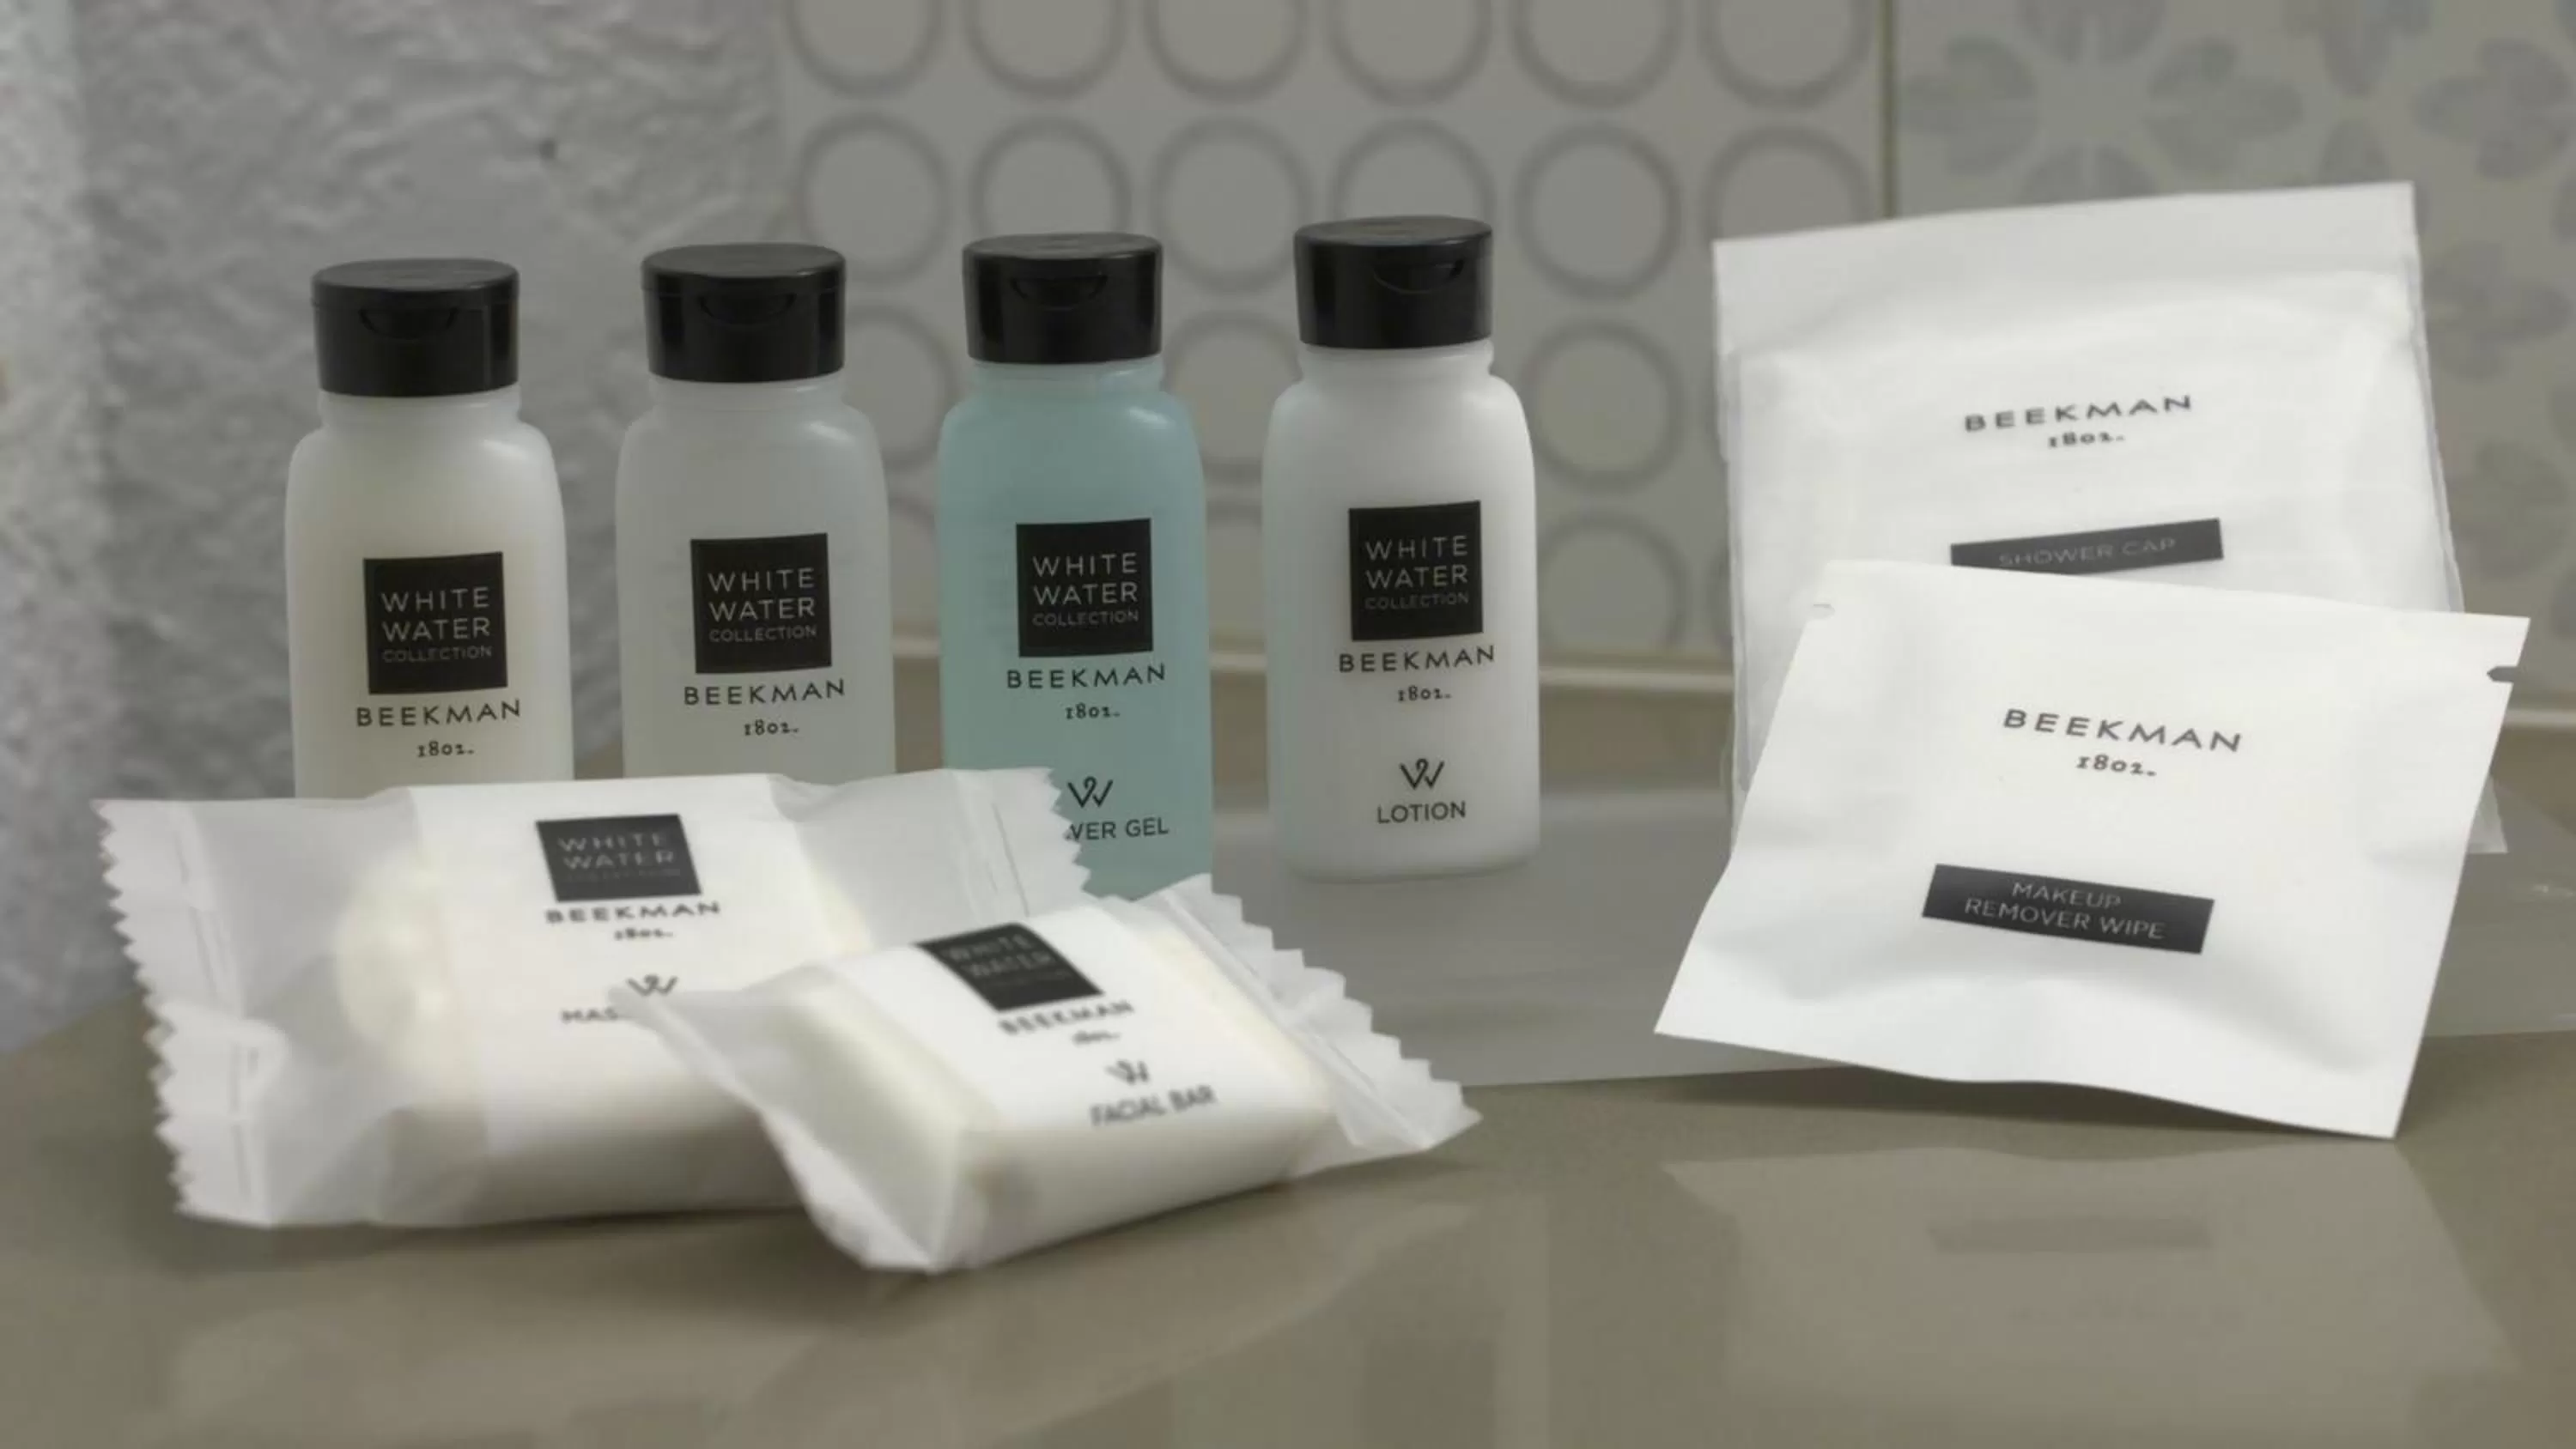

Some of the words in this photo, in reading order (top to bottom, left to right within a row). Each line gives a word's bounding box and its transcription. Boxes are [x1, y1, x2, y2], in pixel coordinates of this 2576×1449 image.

[1965, 394, 2192, 433] BEEKMAN
[1364, 534, 1468, 561] WHITE
[1998, 543, 2114, 568] SHOWER
[2121, 537, 2178, 557] CAP
[1031, 551, 1138, 578] WHITE
[1364, 564, 1469, 591] WATER
[707, 567, 815, 592] WHITE
[381, 585, 489, 614] WHITE
[1032, 581, 1139, 606] WATER
[1364, 591, 1470, 610] COLLECTION
[708, 596, 816, 622] WATER
[1031, 609, 1139, 627] COLLECTION
[382, 616, 490, 643] WATER
[708, 623, 817, 644] COLLECTION
[382, 644, 493, 664] COLLECTION
[1338, 645, 1496, 673] BEEKMAN
[1006, 663, 1166, 690] BEEKMAN
[683, 678, 845, 706] BEEKMAN
[356, 699, 520, 727] BEEKMAN
[2003, 708, 2242, 753] BEEKMAN
[1376, 800, 1467, 825] LOTION
[1125, 816, 1170, 838] GEL
[2011, 882, 2122, 911] MAKEUP
[544, 901, 720, 923] BEEKMAN
[1964, 898, 2091, 931] REMOVER
[2099, 916, 2168, 941] WIPE
[1090, 1095, 1167, 1126] FACIAL
[1169, 1085, 1216, 1113] BAR
